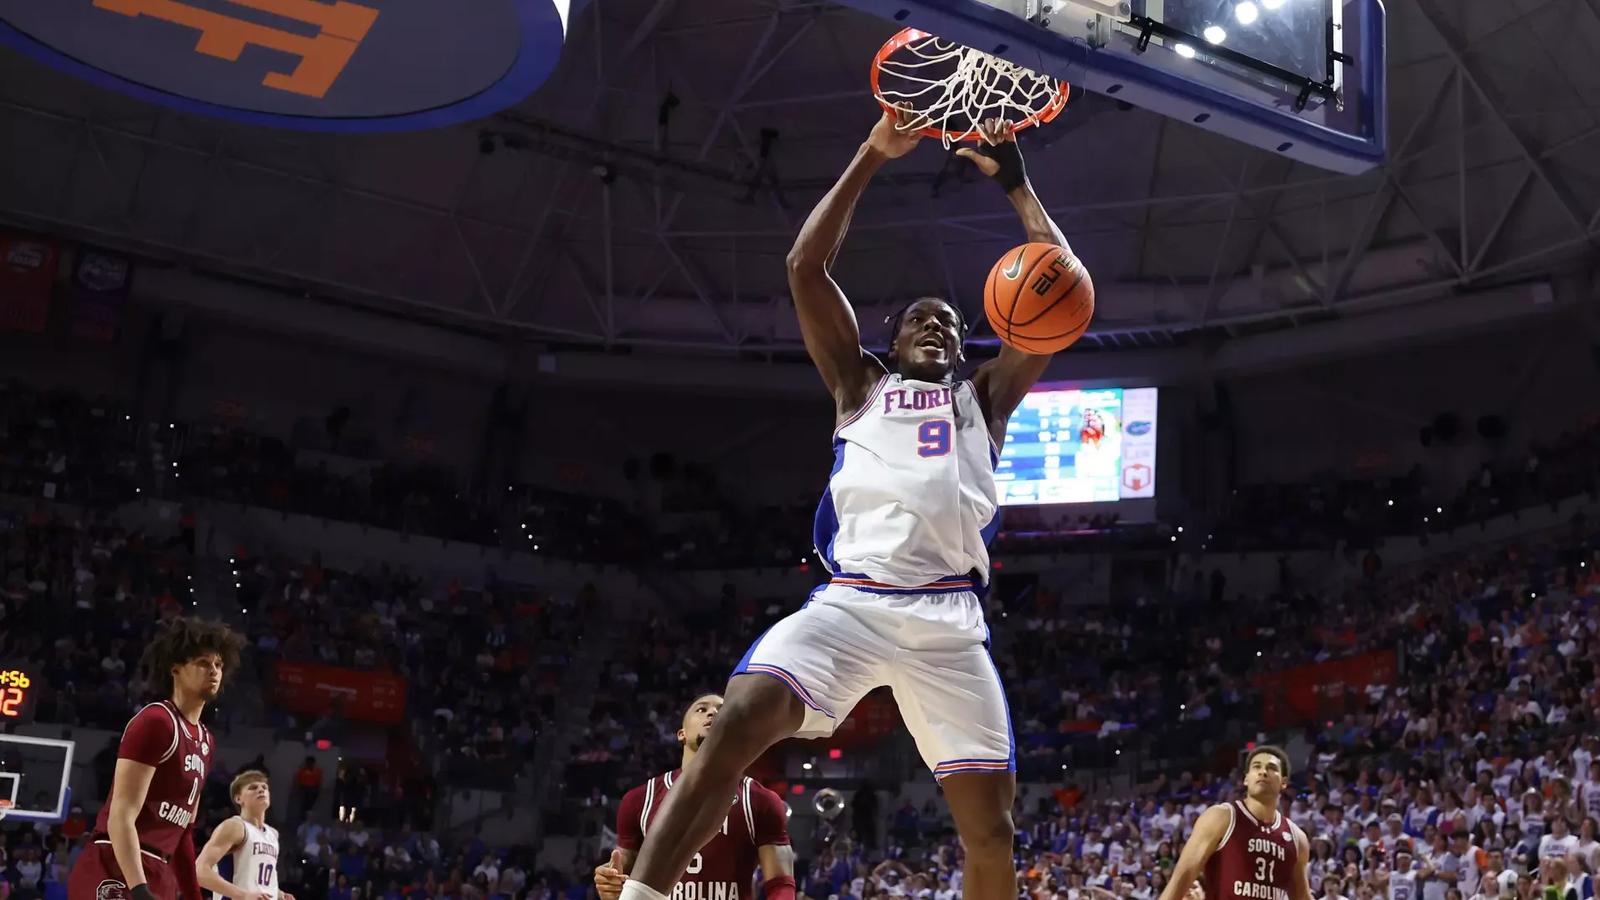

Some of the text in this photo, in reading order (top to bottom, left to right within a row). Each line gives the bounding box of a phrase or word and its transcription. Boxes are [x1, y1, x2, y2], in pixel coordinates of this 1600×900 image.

[884, 388, 951, 415] FLORI
[917, 419, 952, 458] 9
[187, 777, 198, 805] 0
[158, 801, 191, 829] CAROL
[1247, 838, 1285, 861] SOUTH
[257, 862, 274, 887] 10
[1255, 857, 1275, 883] 31
[669, 881, 739, 900] ROLINA
